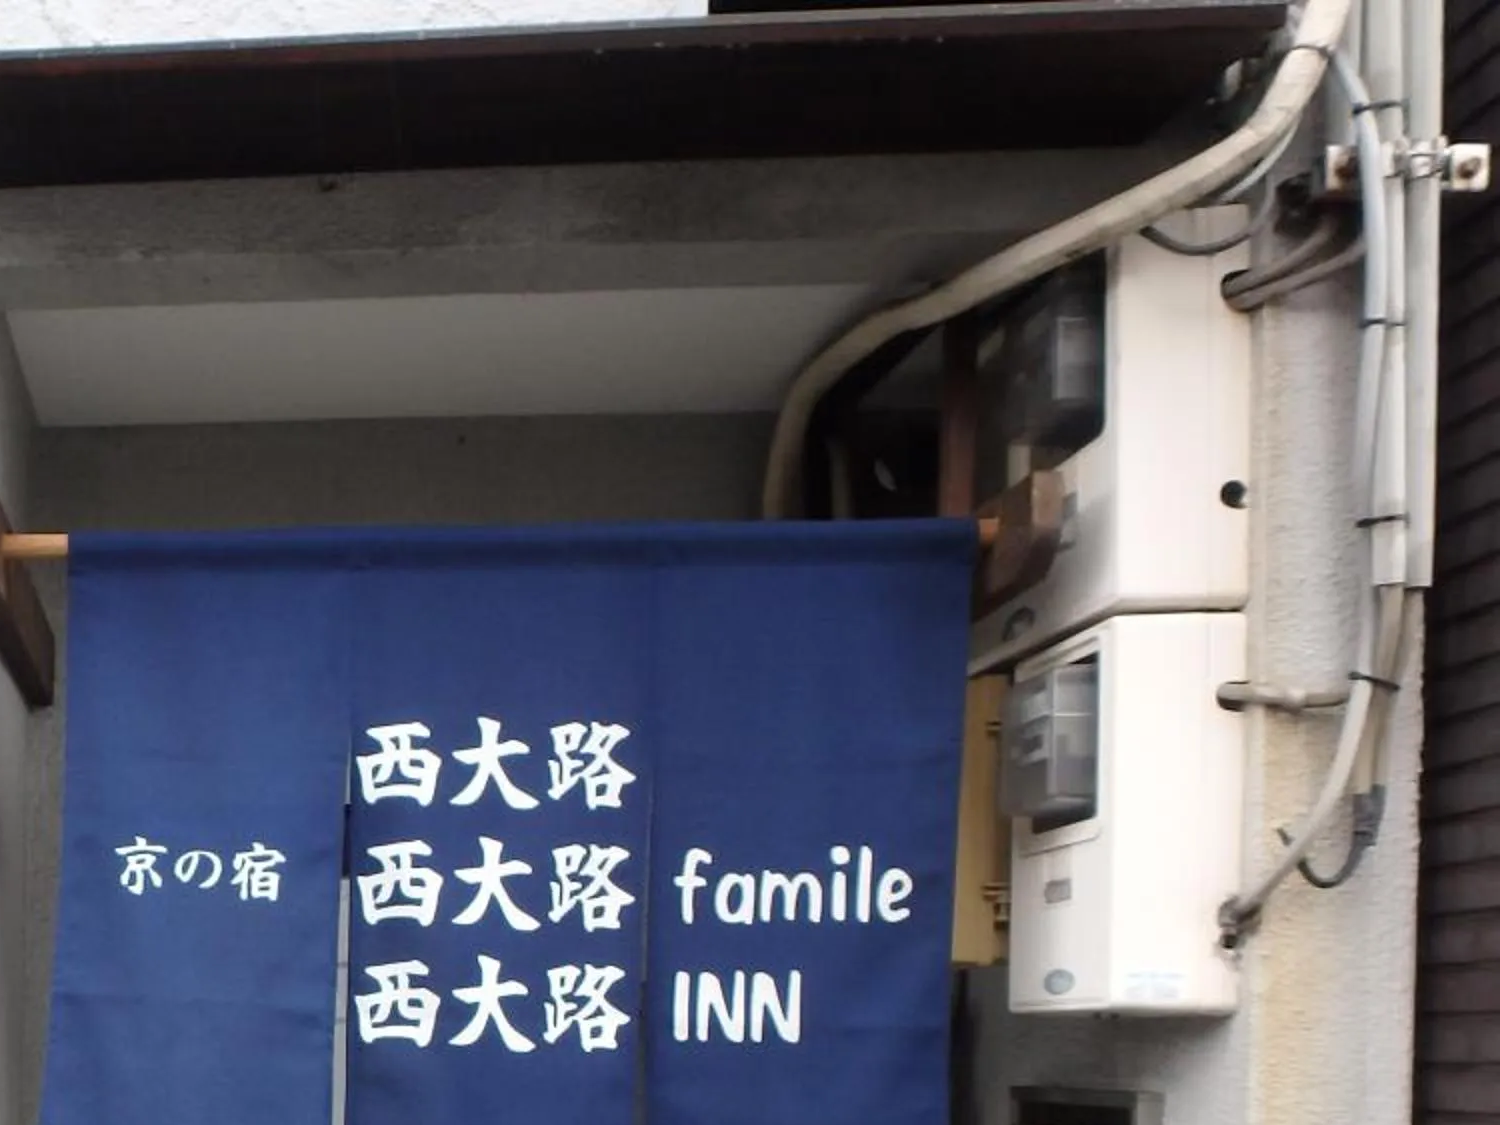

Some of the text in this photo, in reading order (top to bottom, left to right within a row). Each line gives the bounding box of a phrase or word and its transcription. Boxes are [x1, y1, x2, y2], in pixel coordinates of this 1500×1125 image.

[355, 717, 637, 810] 西大路
[115, 836, 287, 902] 京の宿
[357, 837, 913, 932] 西大路 famile
[354, 955, 801, 1052] 西大路 INN
